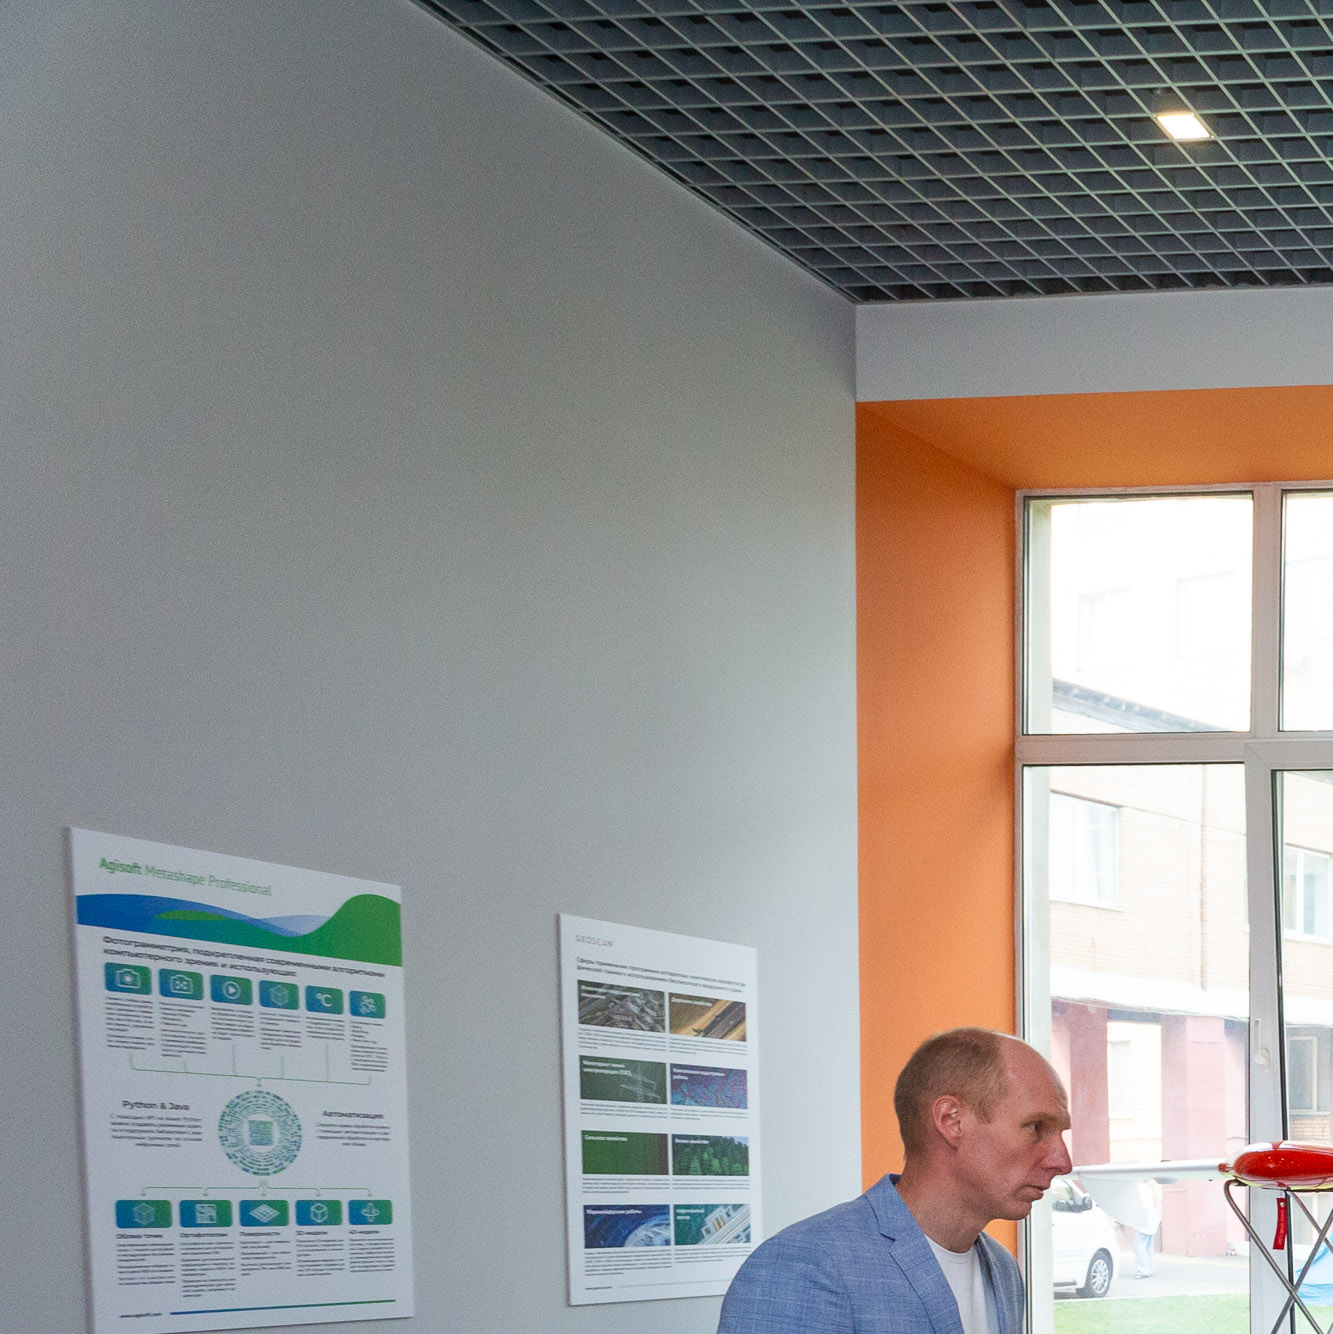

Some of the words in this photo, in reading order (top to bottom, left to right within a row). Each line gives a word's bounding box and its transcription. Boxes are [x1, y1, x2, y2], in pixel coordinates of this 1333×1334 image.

[99, 856, 142, 876] Agisoft
[144, 864, 206, 887] Metashape
[208, 875, 272, 896] Professional
[122, 1100, 158, 1112] Python
[169, 1101, 190, 1112] Java
